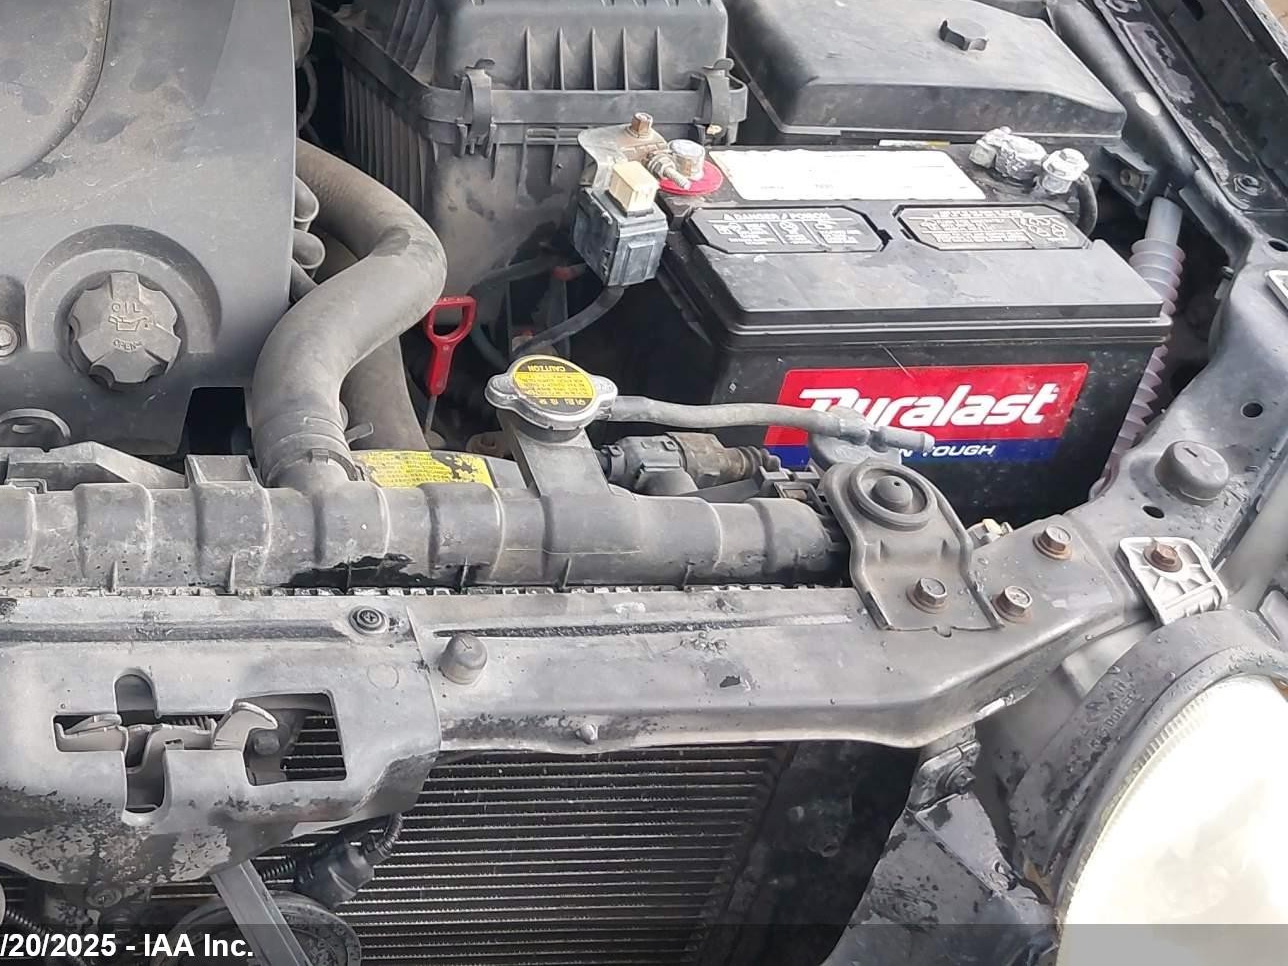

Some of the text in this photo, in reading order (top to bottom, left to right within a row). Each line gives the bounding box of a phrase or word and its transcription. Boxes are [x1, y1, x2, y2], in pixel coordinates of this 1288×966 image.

[112, 302, 142, 314] OIL
[113, 339, 136, 352] OPEN
[527, 365, 566, 373] CAUTION
[799, 383, 1060, 427] Duralast
